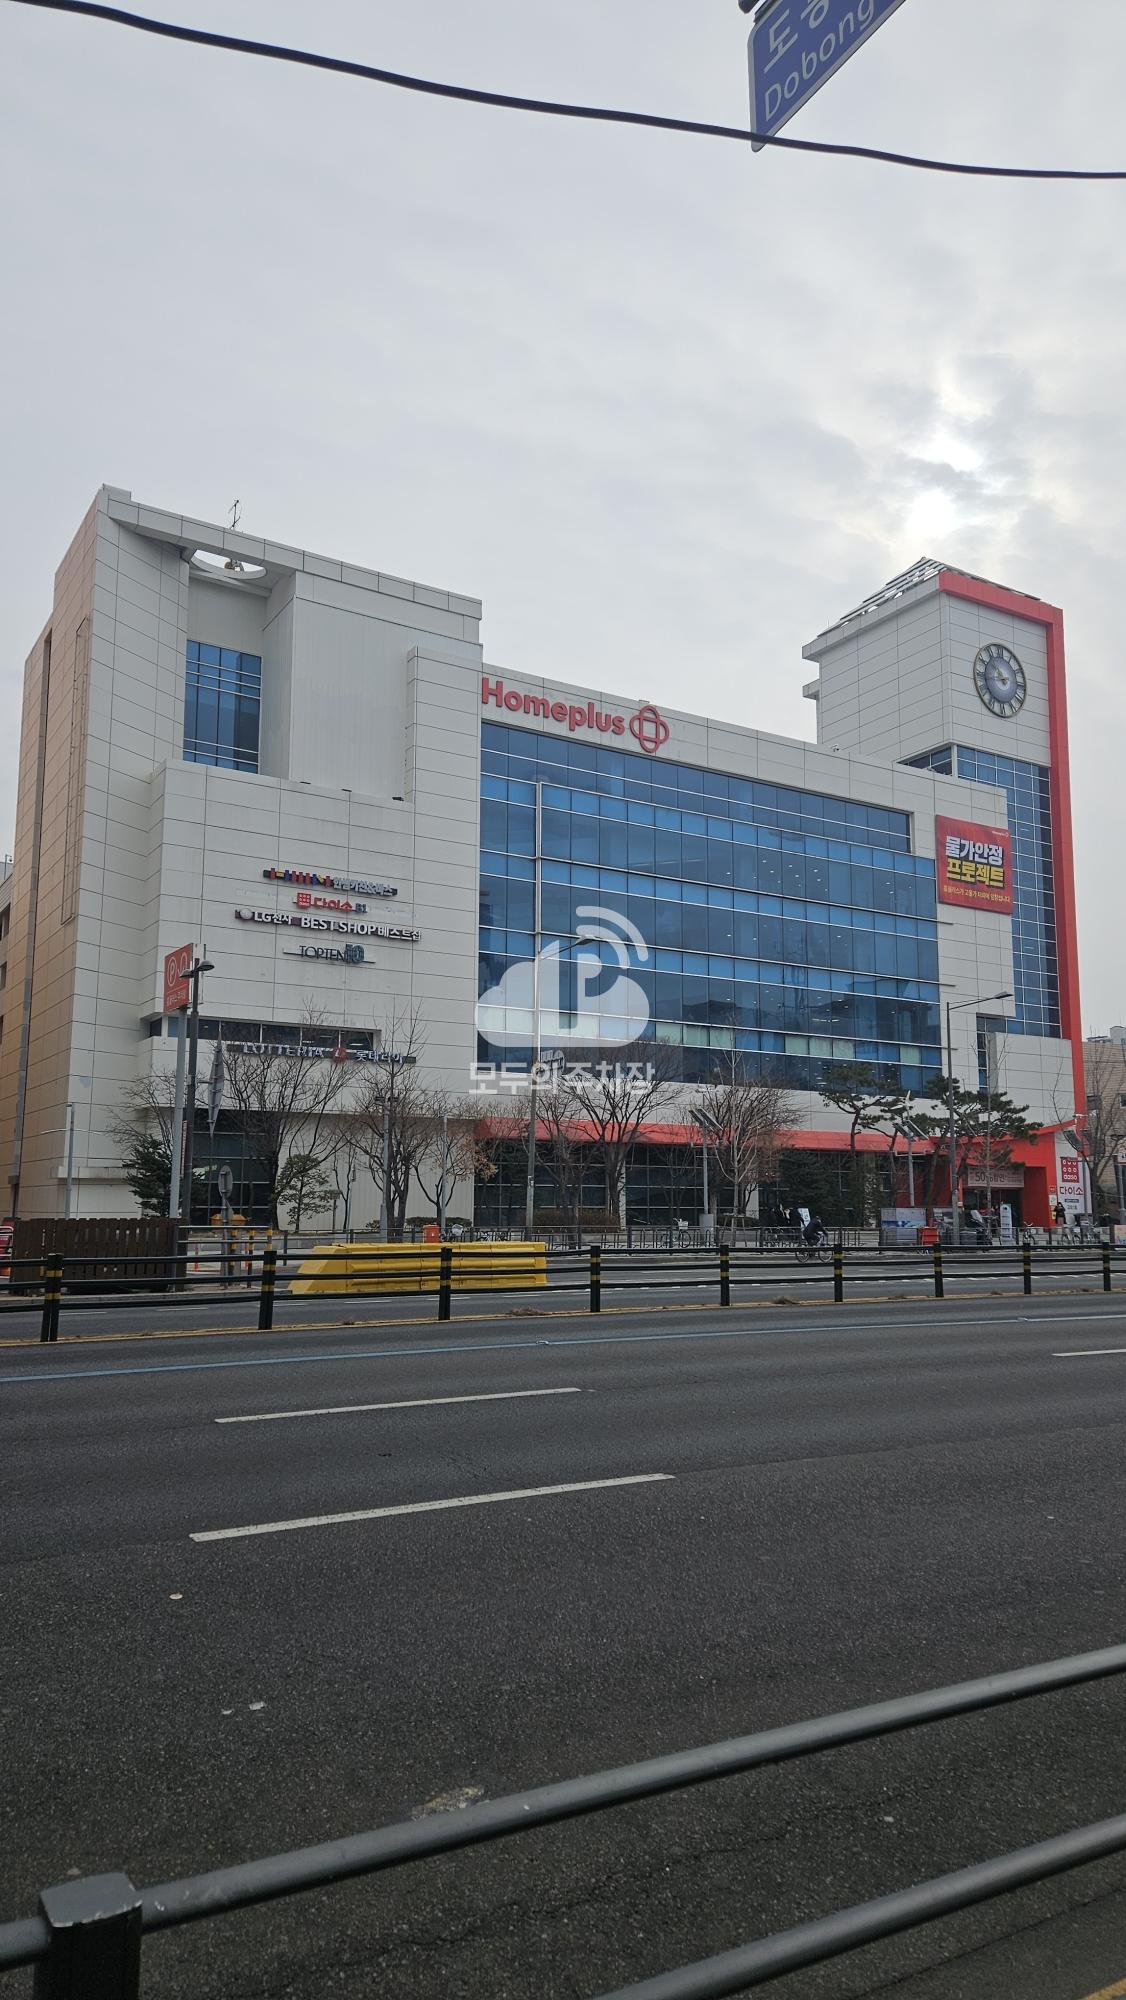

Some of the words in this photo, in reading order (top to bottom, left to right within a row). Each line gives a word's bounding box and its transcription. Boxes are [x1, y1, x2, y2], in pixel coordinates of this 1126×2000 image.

[764, 0, 875, 122] Dobong
[481, 676, 626, 736] Homeplus
[946, 835, 1003, 866] 물가안정
[946, 857, 1004, 888] 프로젝트
[313, 897, 353, 913] 다이소
[254, 911, 293, 925] LG전자
[301, 916, 336, 931] BEST
[339, 921, 377, 936] SHOP
[1059, 1186, 1084, 1196] 다이소
